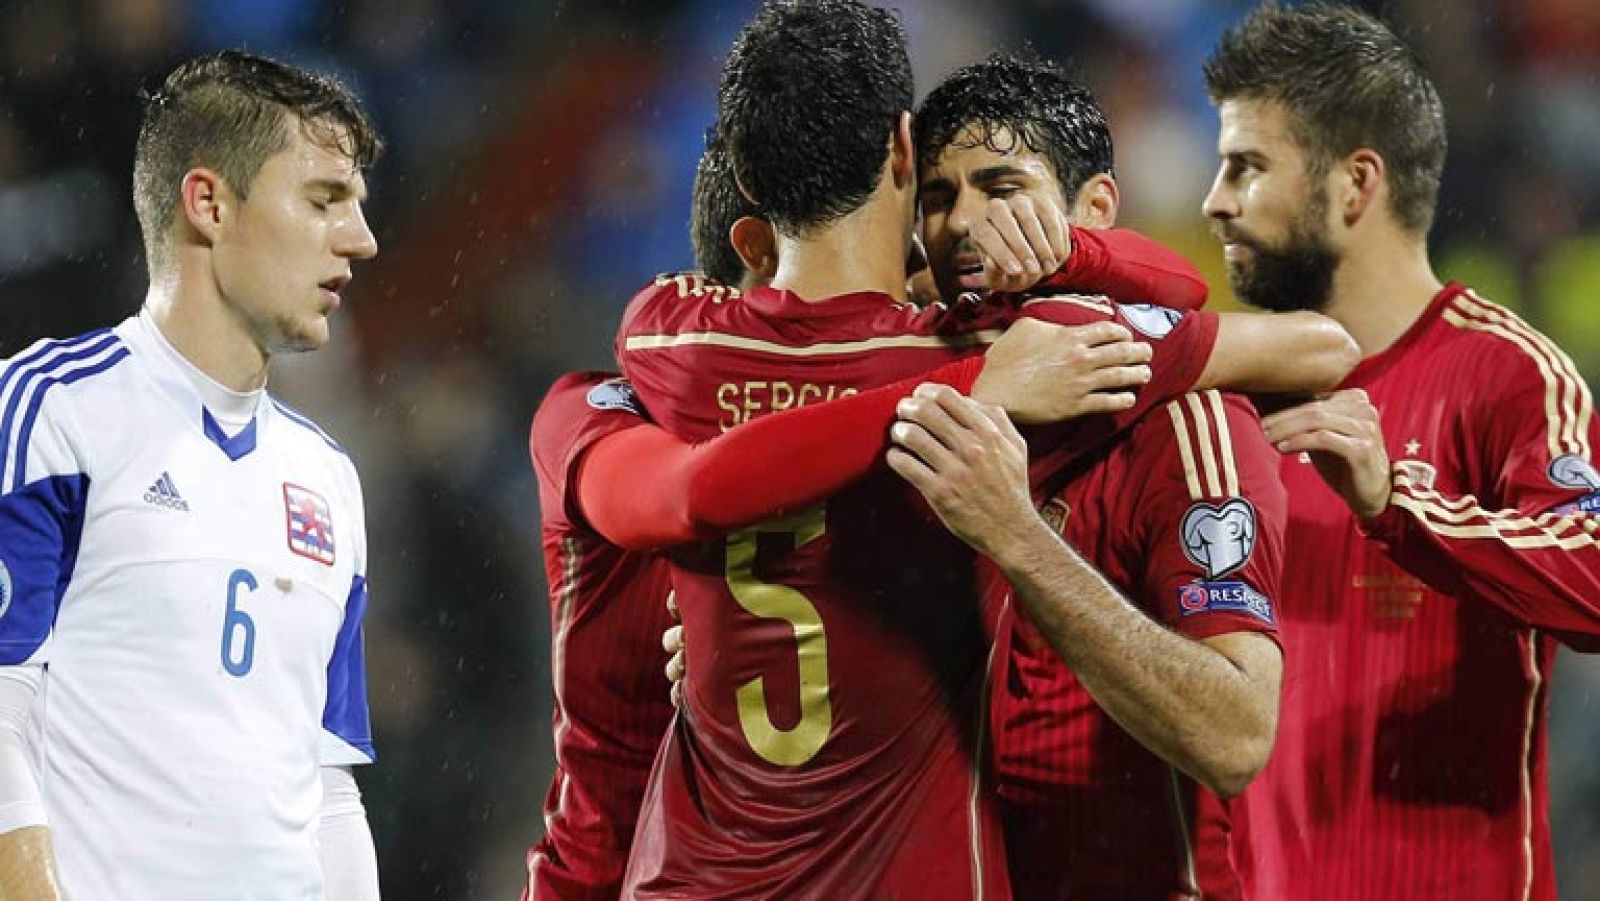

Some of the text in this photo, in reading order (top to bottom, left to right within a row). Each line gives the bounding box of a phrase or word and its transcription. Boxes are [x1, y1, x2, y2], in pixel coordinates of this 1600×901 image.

[717, 381, 858, 433] SER
[221, 568, 259, 677] 6
[725, 501, 832, 767] 5
